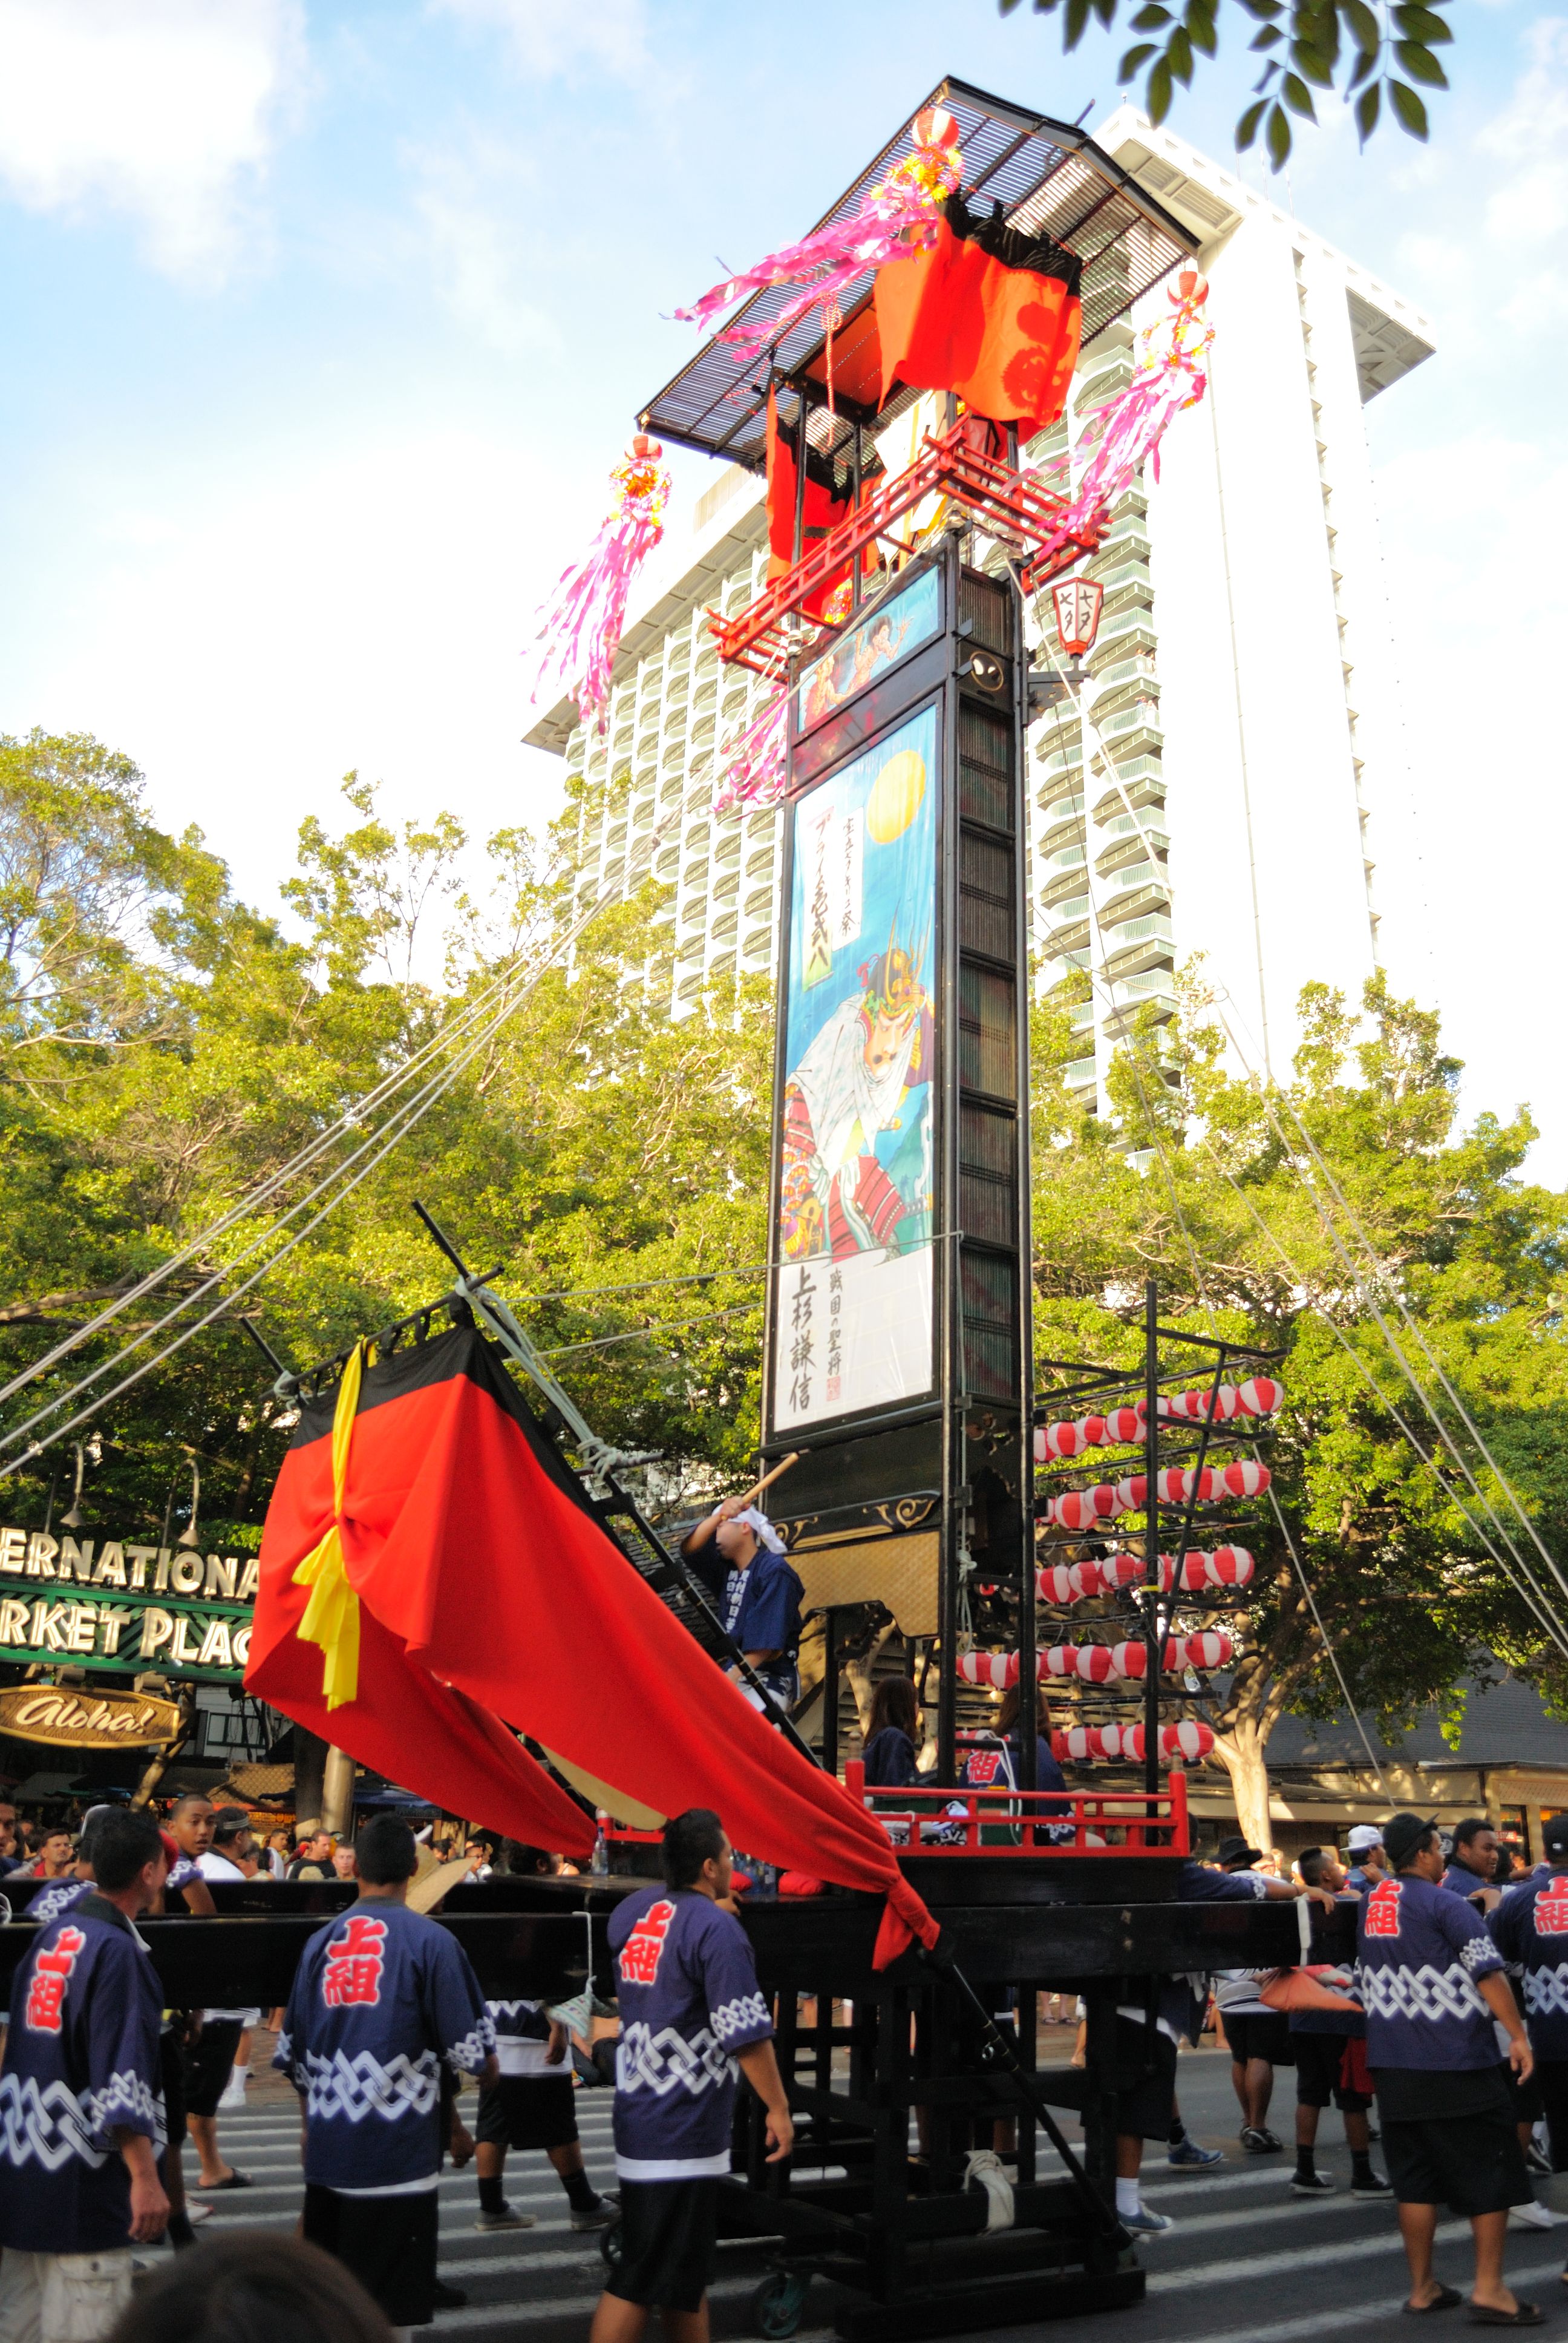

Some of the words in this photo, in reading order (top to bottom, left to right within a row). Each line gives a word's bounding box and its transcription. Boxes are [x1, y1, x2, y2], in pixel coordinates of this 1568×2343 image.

[789, 1265, 817, 1413] 上杉謙信
[16, 1696, 155, 1734] Aloha!
[619, 1899, 676, 1985] 上組
[1365, 1879, 1403, 1937] 上組
[25, 1925, 86, 2035] 上組
[323, 1915, 388, 2007] 上組
